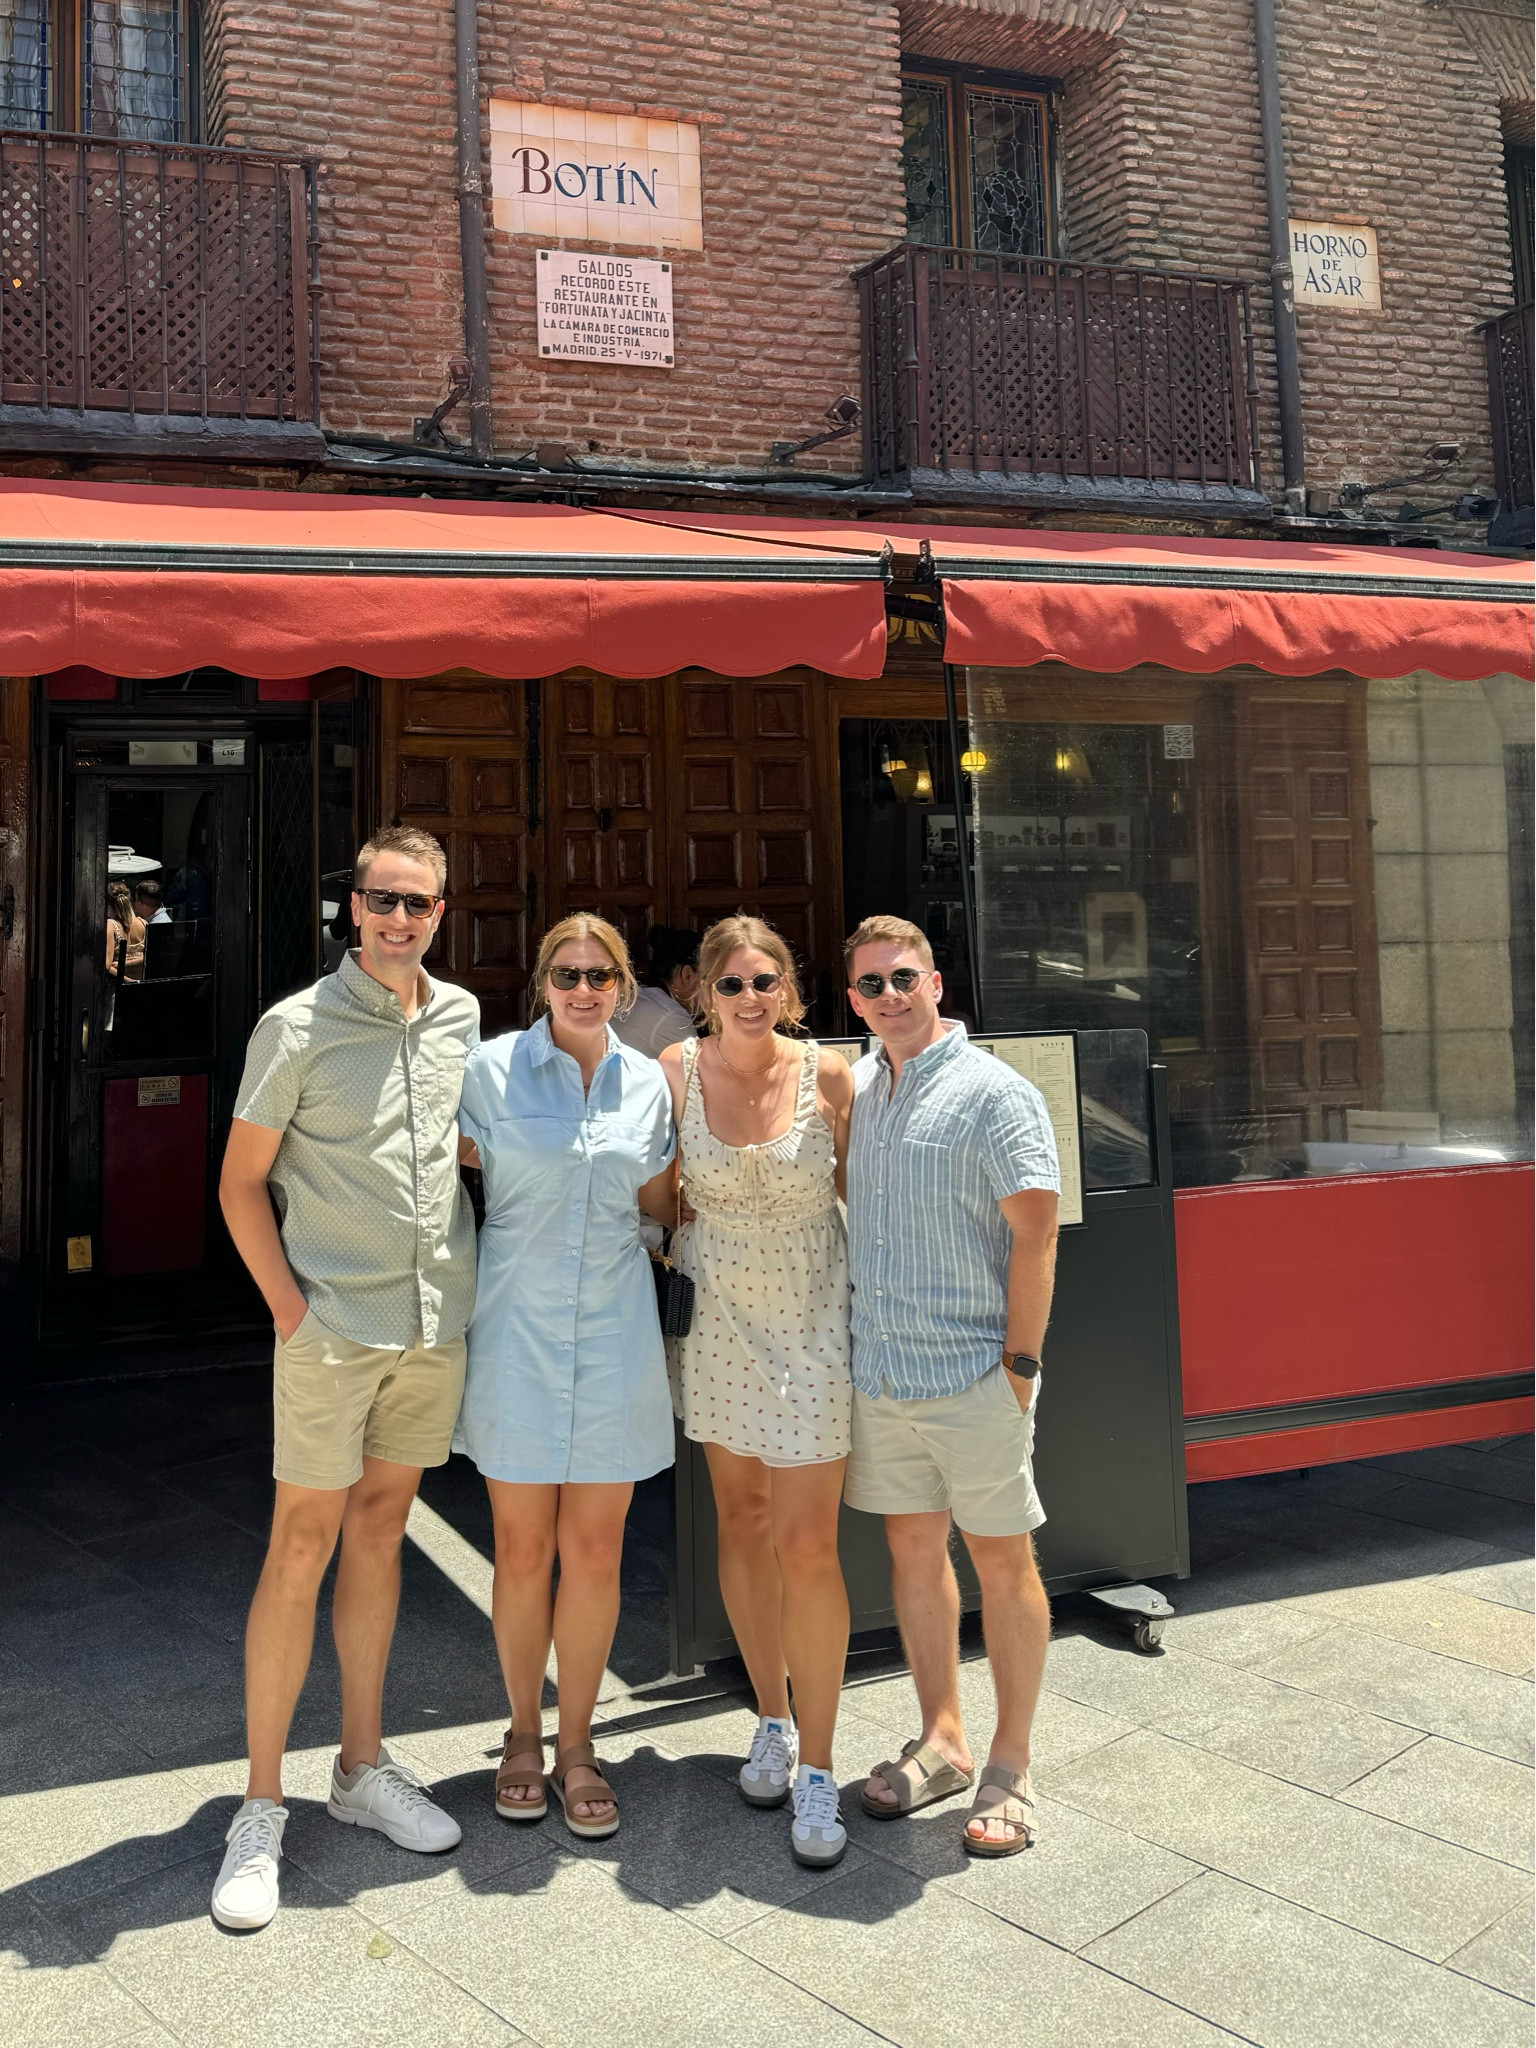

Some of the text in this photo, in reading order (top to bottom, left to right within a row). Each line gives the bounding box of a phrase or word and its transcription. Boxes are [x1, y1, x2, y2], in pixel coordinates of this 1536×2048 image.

[511, 146, 660, 210] BOTÍN
[1293, 232, 1367, 258] HORNO
[578, 259, 633, 278] GALDOS
[1322, 259, 1342, 271] DE
[618, 280, 651, 294] ESTE
[1302, 266, 1365, 299] ASAR
[554, 288, 658, 309] RESTAURANTE EN
[611, 307, 618, 319] Y
[543, 317, 670, 338] LA CÁMARA DE COMERCIO
[552, 343, 600, 357] MADRID.
[573, 333, 645, 348] E INDUSTRIA.
